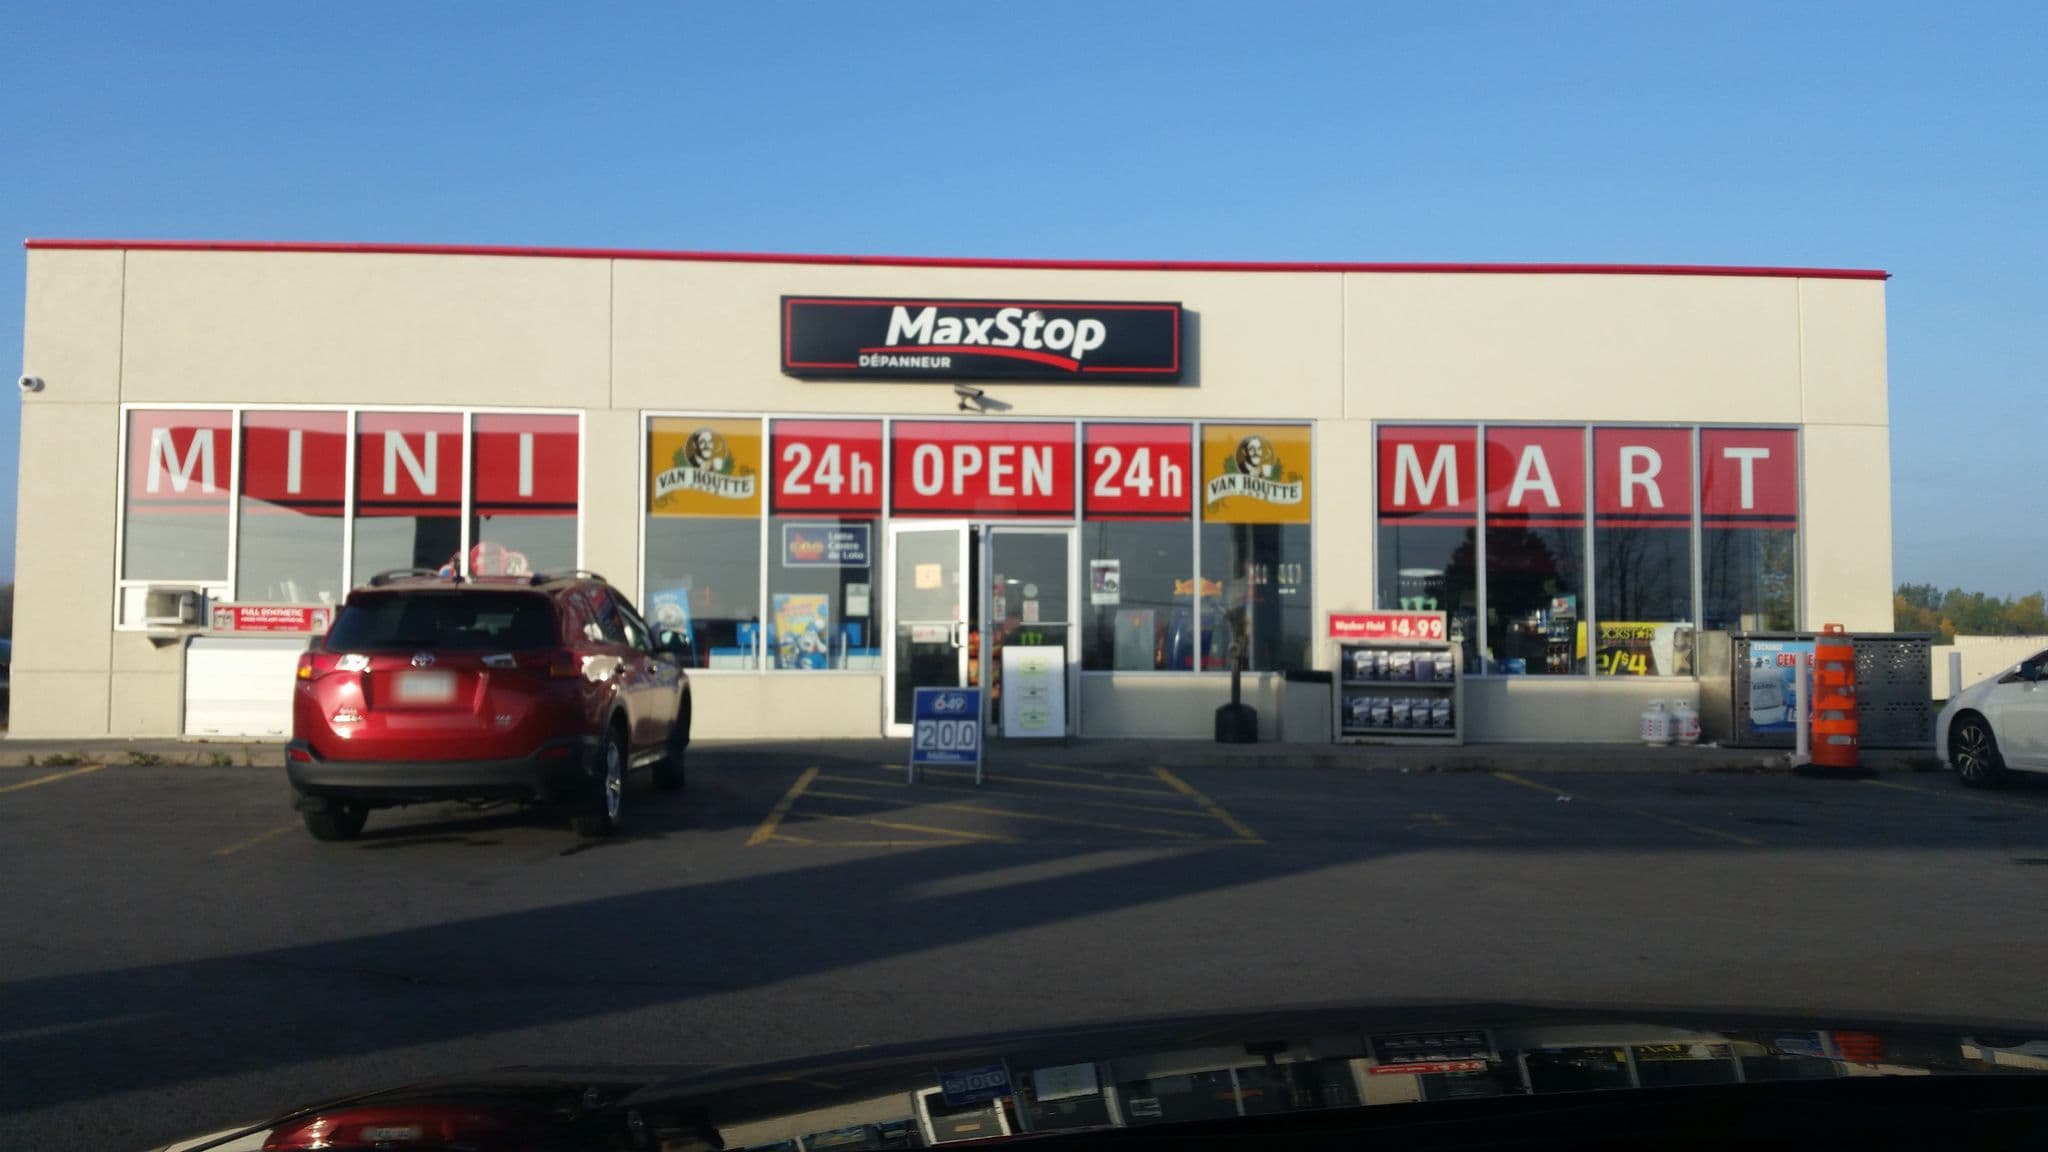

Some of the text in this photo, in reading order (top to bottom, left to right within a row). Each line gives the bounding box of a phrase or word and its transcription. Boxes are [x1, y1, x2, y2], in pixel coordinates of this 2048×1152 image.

[885, 306, 1106, 360] MaxStop
[858, 352, 952, 368] DÉPANNEUR
[146, 428, 533, 496] MINI
[659, 469, 750, 493] VAN HOUTTE
[782, 443, 873, 495] 24h
[912, 443, 1054, 496] OPEN
[1093, 446, 1182, 497] 24h
[1211, 476, 1236, 495] VAN
[1243, 476, 1298, 499] HOUTTE
[1393, 443, 1770, 509] MART
[843, 551, 864, 560] Loto
[1776, 653, 1816, 667] CENE
